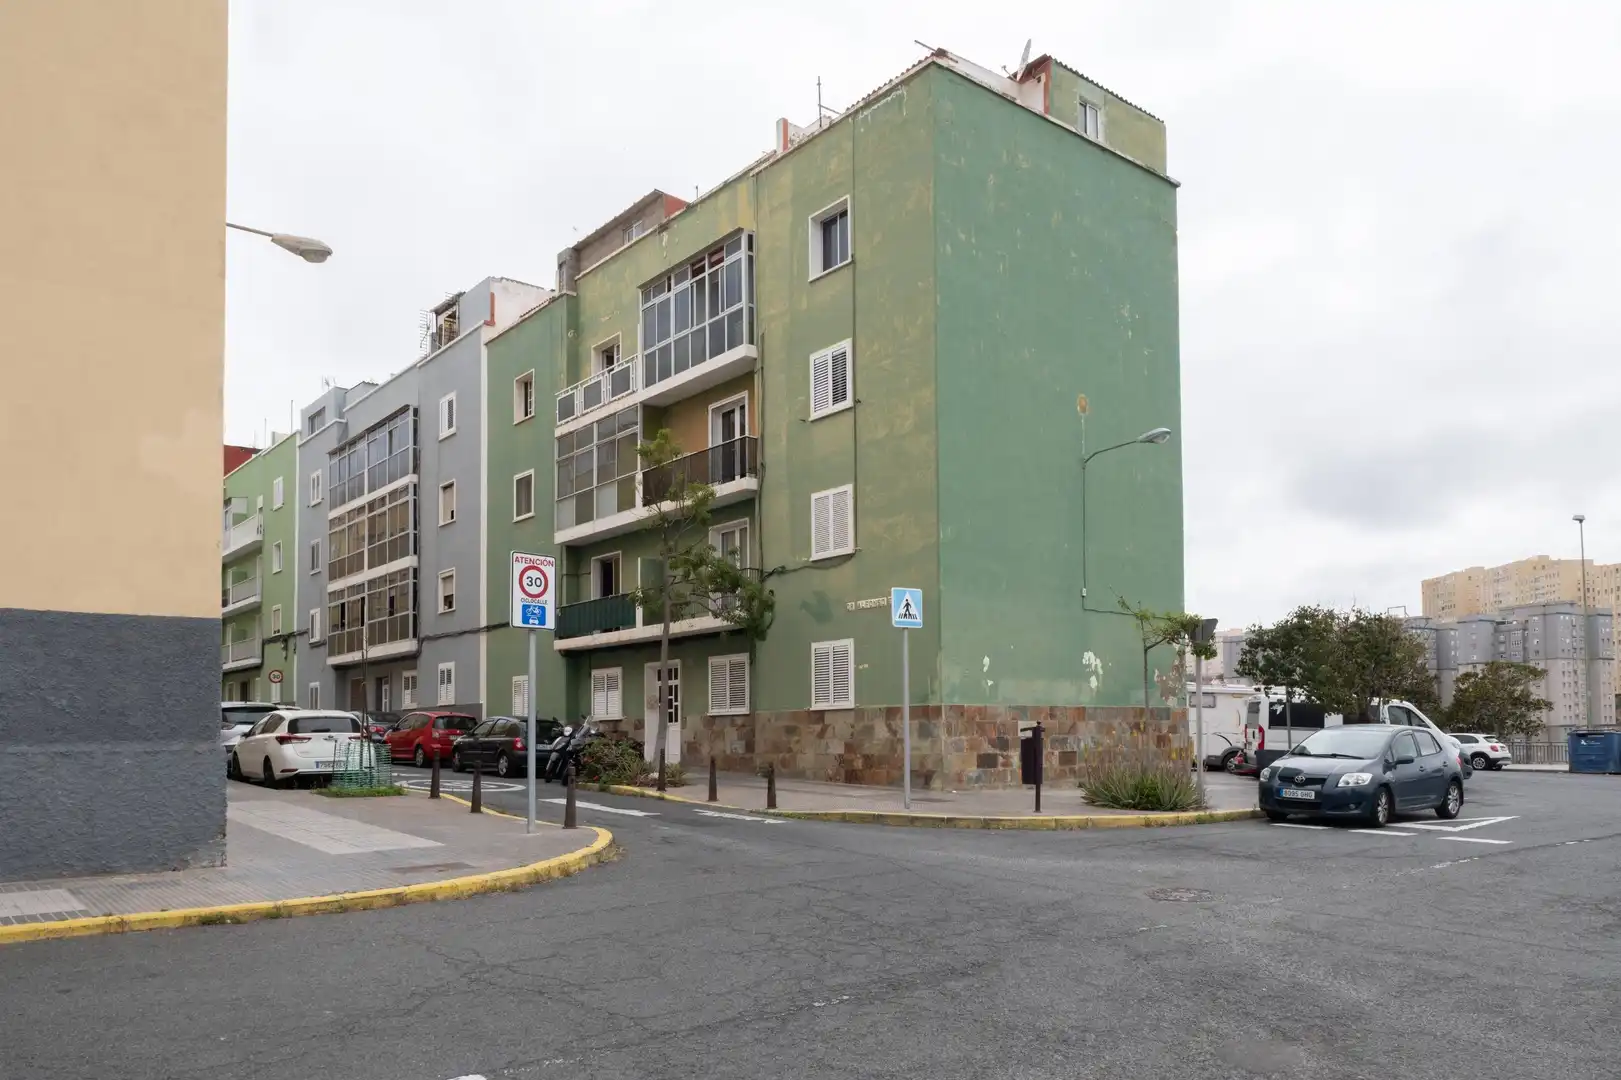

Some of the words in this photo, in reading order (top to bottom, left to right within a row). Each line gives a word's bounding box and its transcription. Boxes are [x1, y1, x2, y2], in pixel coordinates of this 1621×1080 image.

[514, 556, 554, 567] ATENCIÓN
[526, 576, 542, 587] 30
[520, 597, 548, 605] CICLOCALLE
